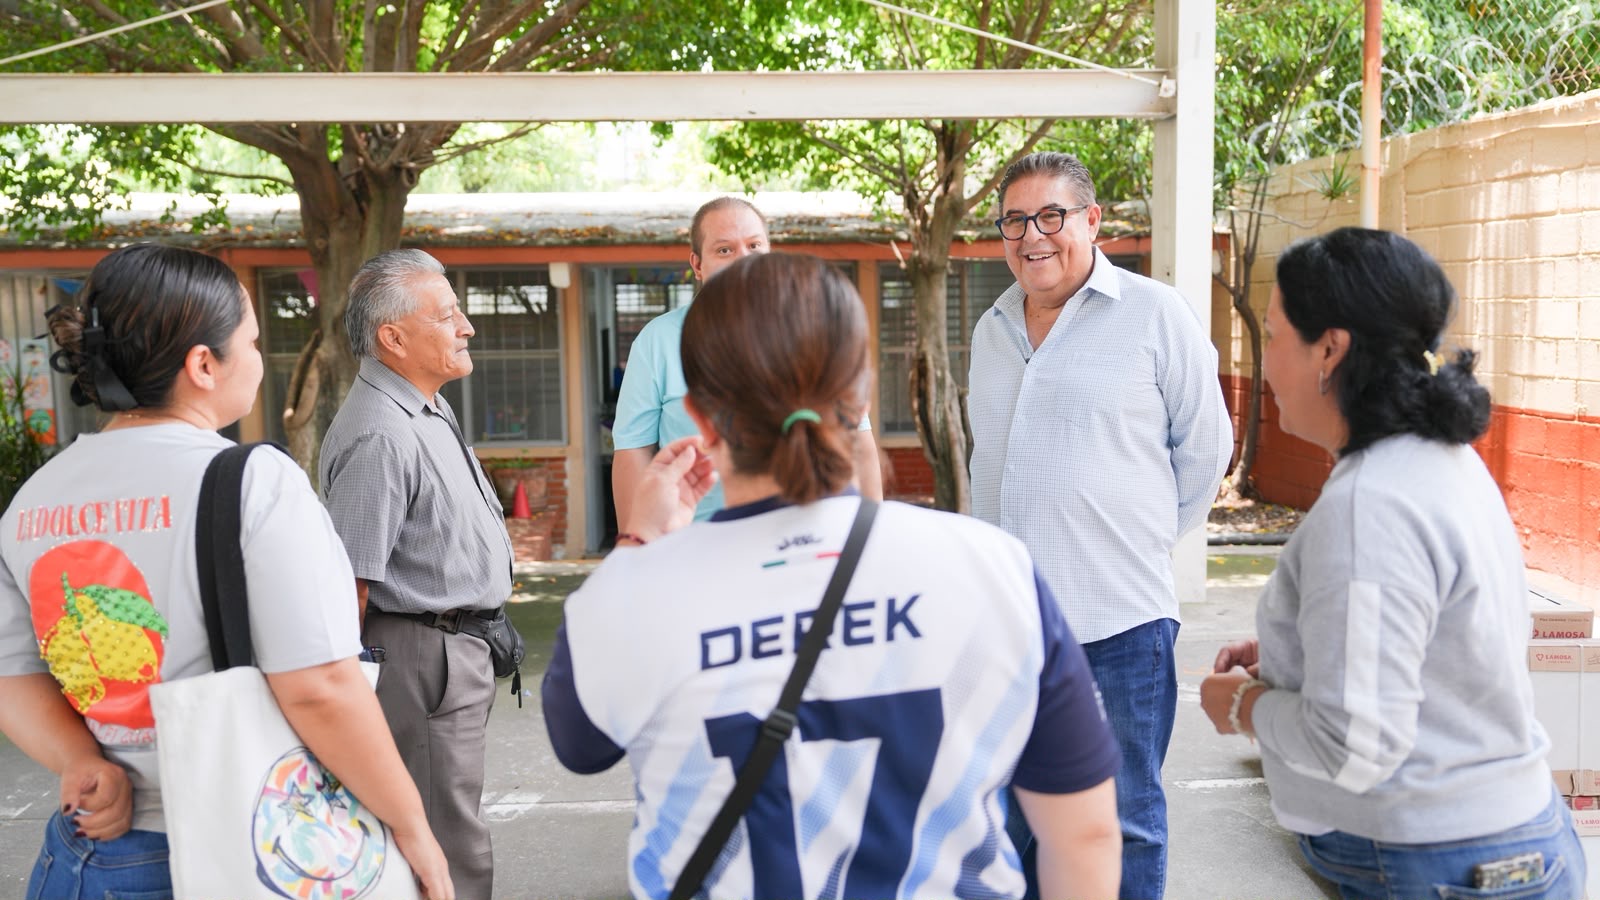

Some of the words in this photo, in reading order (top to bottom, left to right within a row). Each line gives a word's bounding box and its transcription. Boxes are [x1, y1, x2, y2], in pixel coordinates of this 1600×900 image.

[33, 501, 109, 539] DOLCE
[115, 495, 172, 533] VITA
[704, 687, 945, 900] 17
